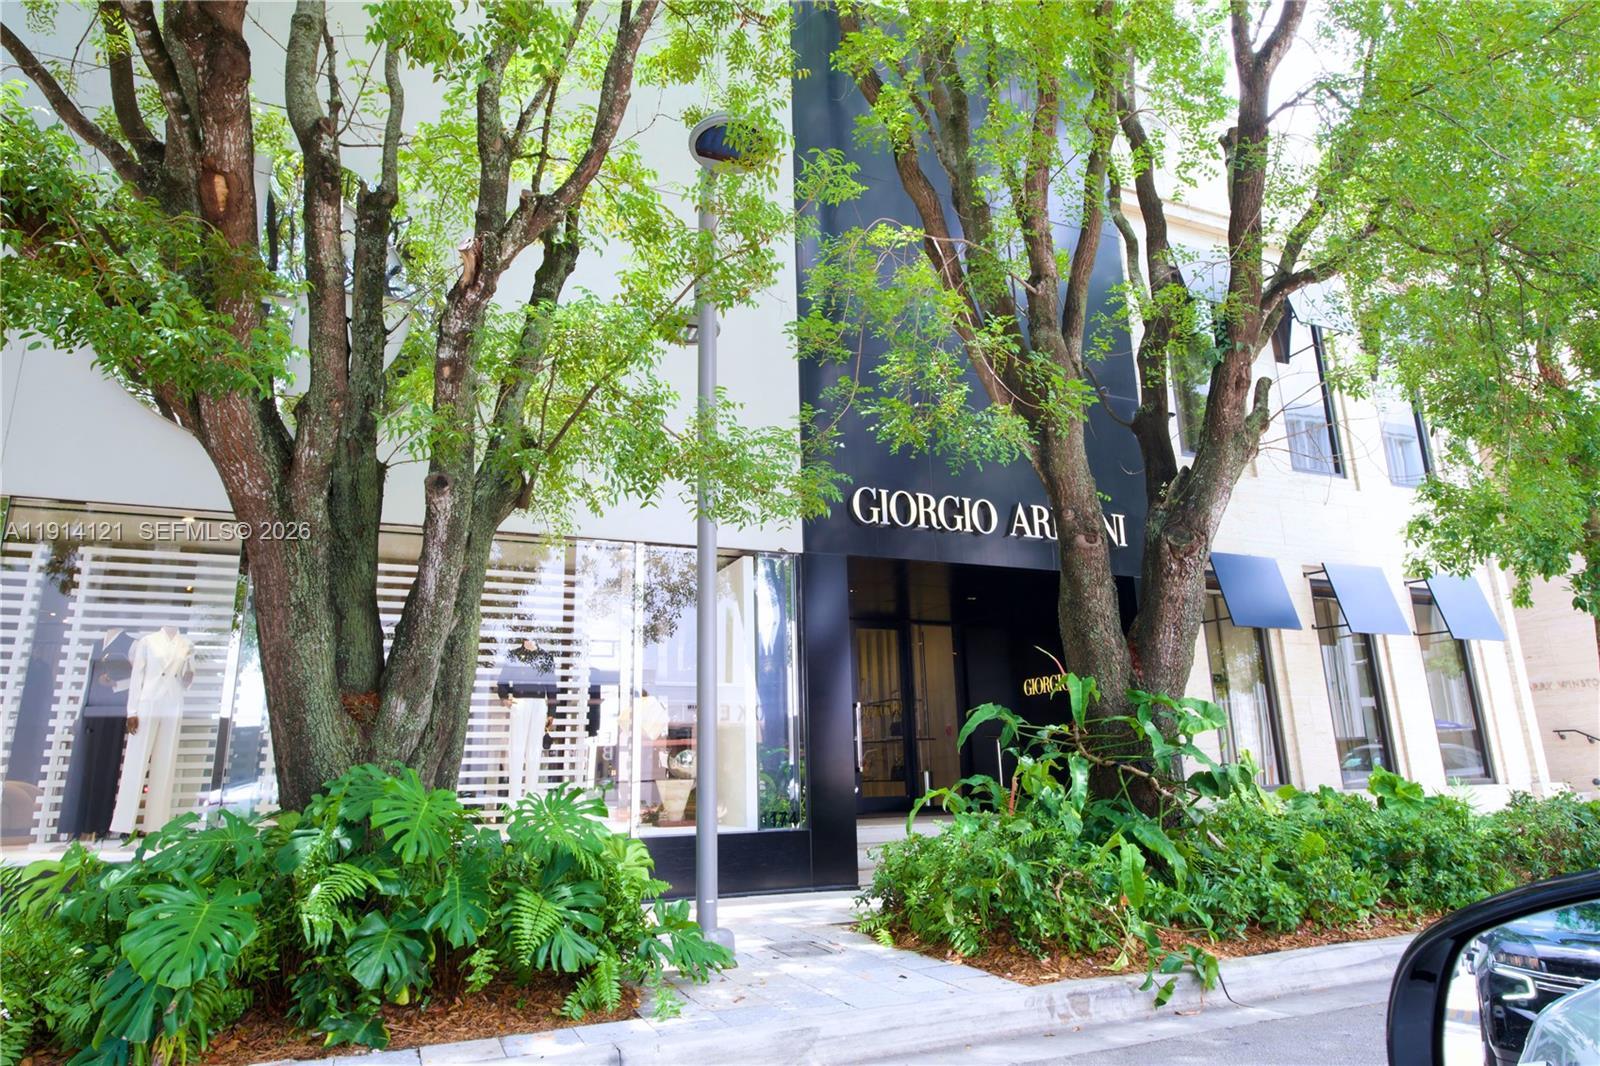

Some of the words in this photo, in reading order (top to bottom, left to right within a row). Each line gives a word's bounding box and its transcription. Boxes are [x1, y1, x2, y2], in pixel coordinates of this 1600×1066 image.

[852, 486, 999, 536] GIORGIO
[1010, 502, 1129, 548] ARNI
[1023, 673, 1071, 697] GIORGI
